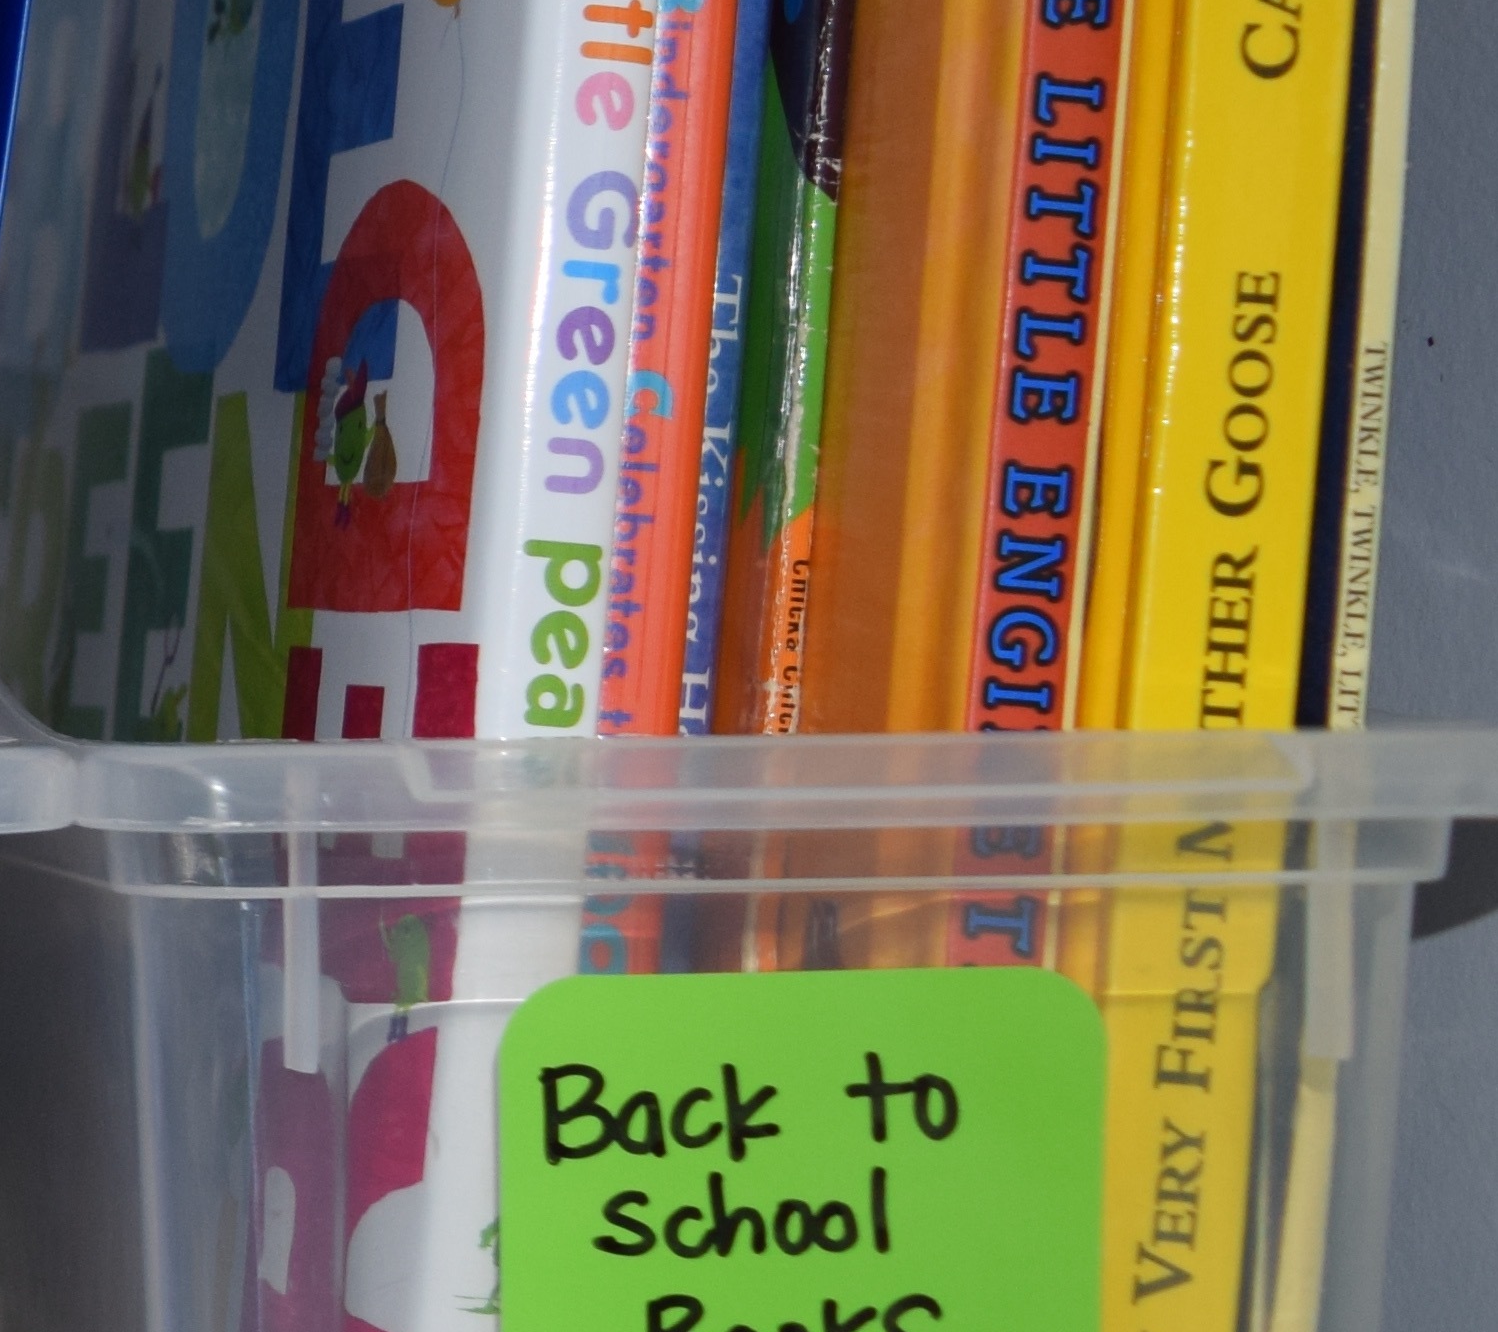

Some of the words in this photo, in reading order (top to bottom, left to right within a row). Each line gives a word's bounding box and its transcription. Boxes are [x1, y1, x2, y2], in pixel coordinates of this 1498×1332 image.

[543, 169, 644, 495] Green
[1005, 76, 1105, 427] LITTLE
[1204, 270, 1279, 518] GOOSE
[1349, 339, 1388, 495] TWINKLE,
[522, 536, 612, 729] pea
[1338, 504, 1375, 658] TWINKLE,
[538, 1062, 781, 1166] Back
[844, 1050, 960, 1143] to
[592, 1165, 891, 1259] school
